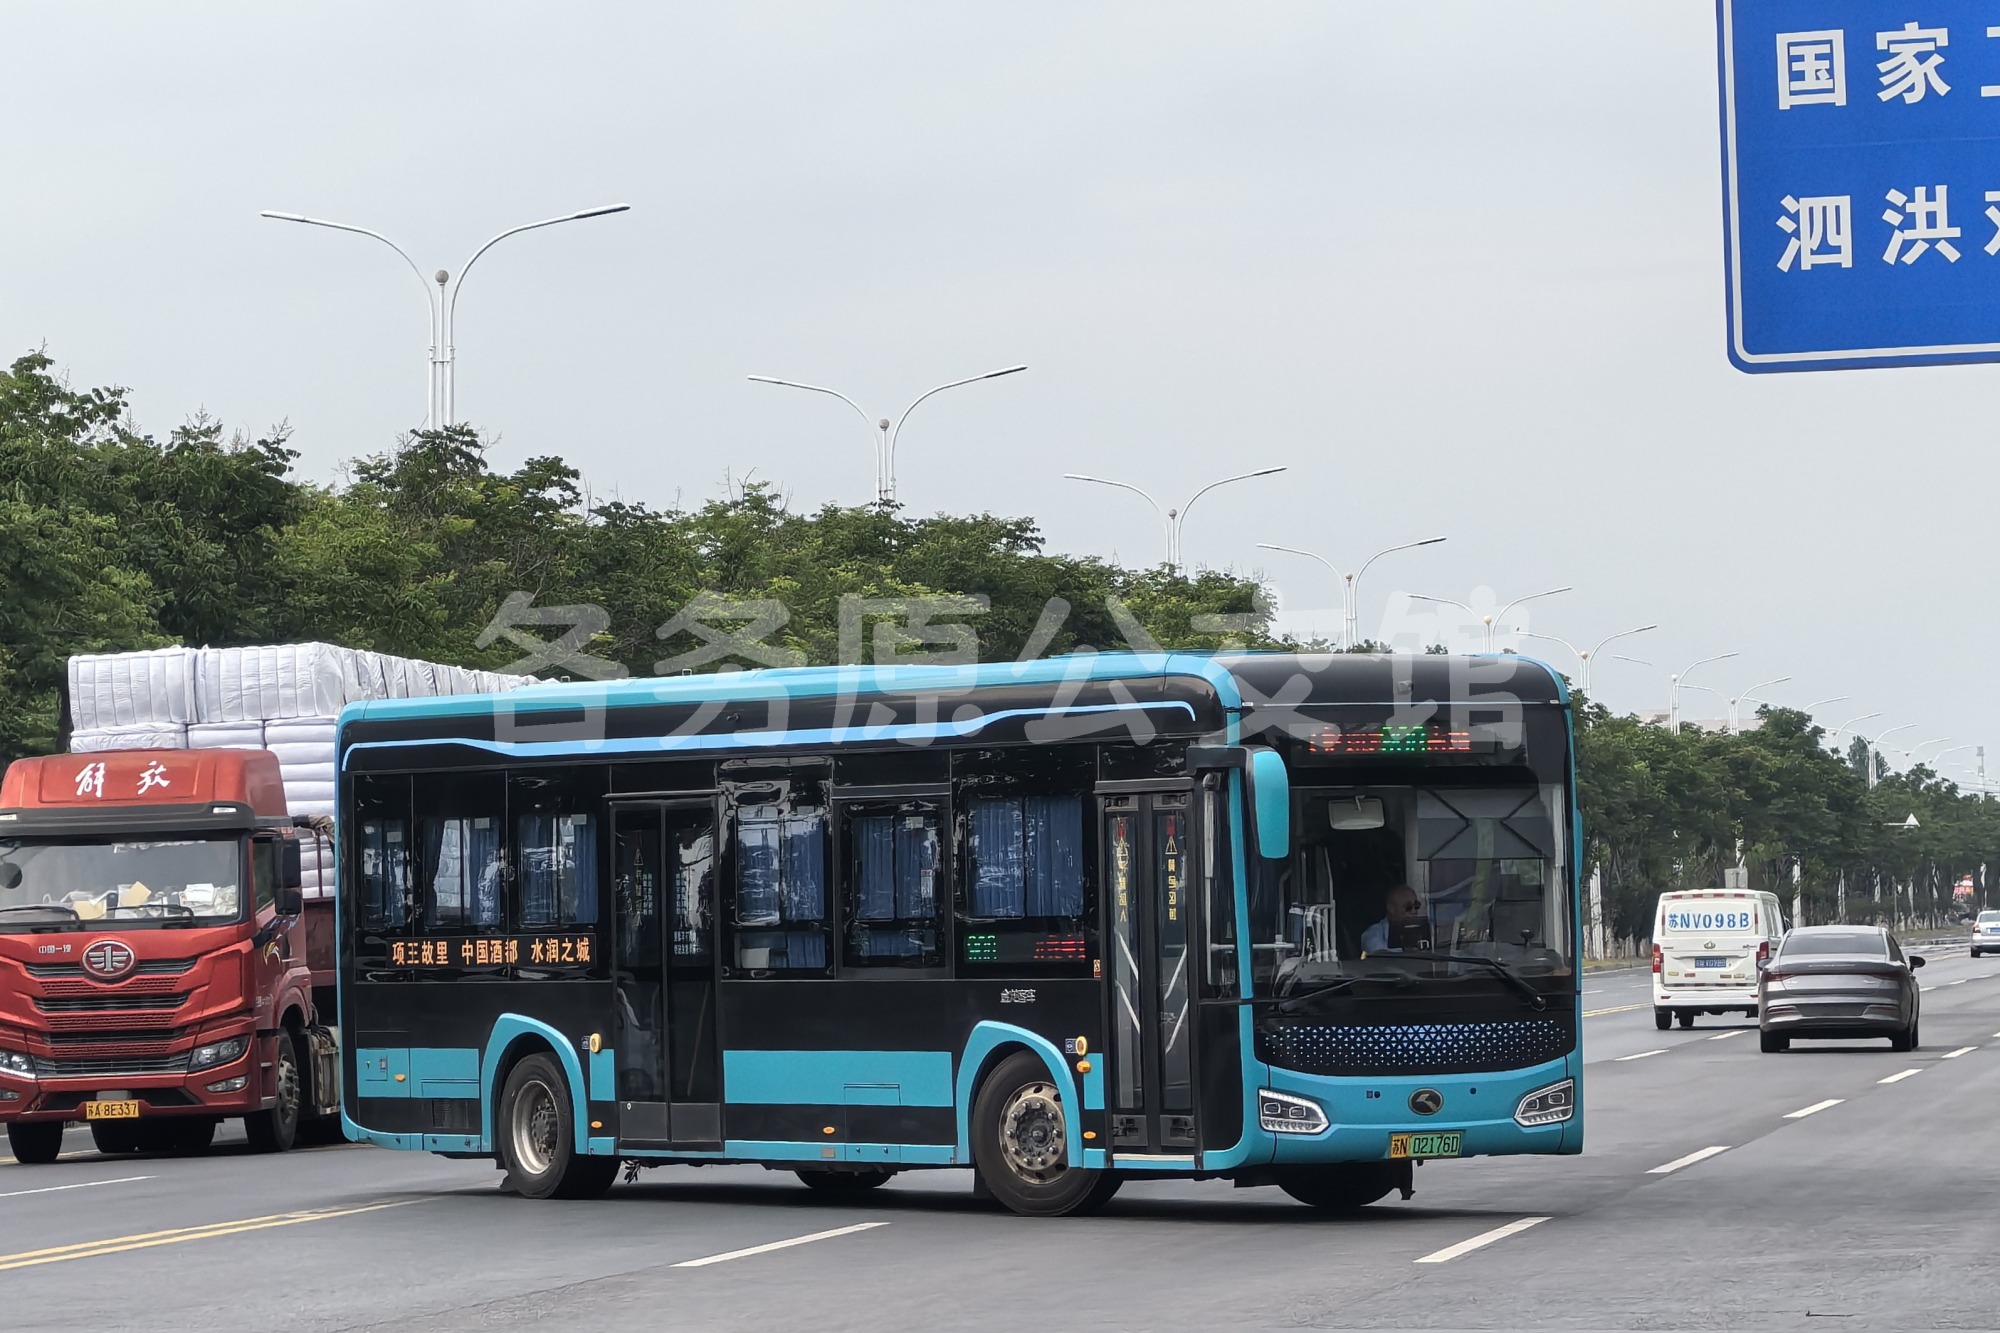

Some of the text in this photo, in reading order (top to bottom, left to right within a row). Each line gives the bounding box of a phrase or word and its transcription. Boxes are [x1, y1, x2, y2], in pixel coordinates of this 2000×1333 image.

[1776, 21, 2000, 110] 国家
[1776, 185, 2000, 273] 泗洪
[75, 761, 171, 797] 解放
[1668, 913, 1749, 929] 苏NV098B
[392, 937, 590, 966] 项王故里 中国酒都 水润之城
